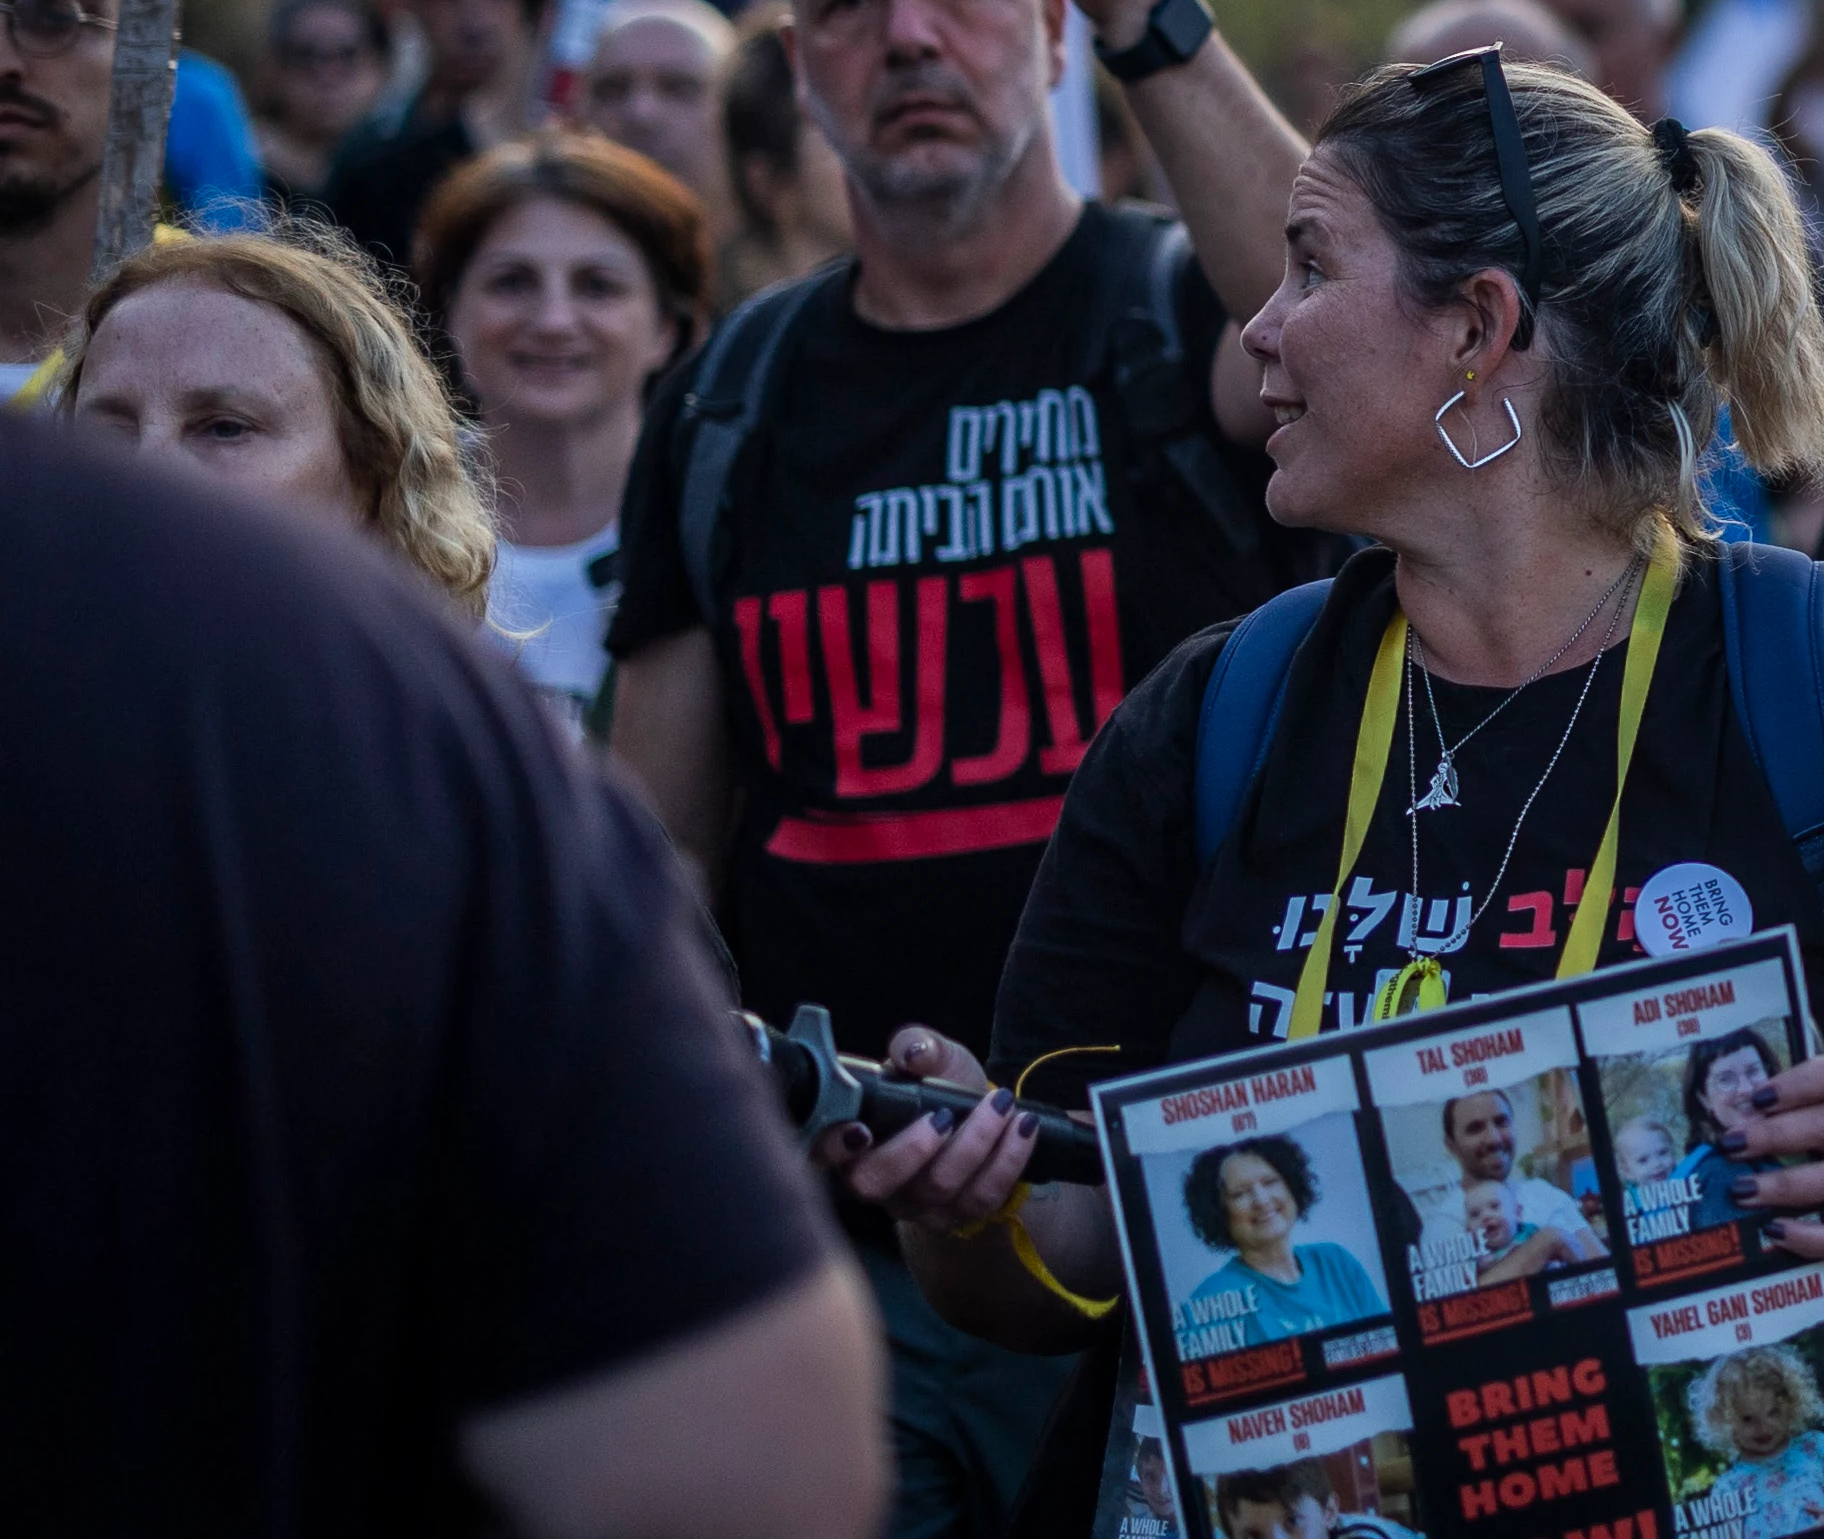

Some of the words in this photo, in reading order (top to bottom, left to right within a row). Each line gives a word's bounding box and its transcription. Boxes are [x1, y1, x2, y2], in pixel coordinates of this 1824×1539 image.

[848, 479, 994, 569] הביתה
[1002, 460, 1114, 552] אותם
[1653, 895, 1690, 950] NOW
[1671, 889, 1702, 938] HOME
[1688, 882, 1716, 927] THEM
[1703, 878, 1734, 927] BRING
[1632, 999, 1661, 1027] ADI
[1664, 979, 1736, 1020] SHOHAM
[1415, 1046, 1451, 1076] TAL
[1450, 1027, 1525, 1068] SHOHAM
[1159, 1080, 1249, 1127] SHOSHAN
[1251, 1065, 1317, 1105] HARAN
[1623, 1188, 1638, 1218] A
[1638, 1172, 1704, 1212] WHOLE
[1408, 1242, 1422, 1274] A
[1421, 1227, 1493, 1269] WHOLE
[1626, 1204, 1692, 1248] FAMILY
[1412, 1260, 1479, 1303] FAMILY
[1651, 1304, 1705, 1340] YAHEL
[1706, 1293, 1750, 1326] GANI
[1751, 1272, 1824, 1315] SHOHAM
[1172, 1301, 1188, 1331] A
[1188, 1283, 1262, 1327] WHOLE
[1176, 1318, 1248, 1362] FAMILY
[1227, 1407, 1288, 1445] NAVEH
[1289, 1386, 1368, 1429] SHOHAM
[1446, 1357, 1607, 1429] BRING
[1458, 1404, 1611, 1471] THEM
[1460, 1448, 1620, 1520] HOME
[1130, 1516, 1169, 1537] WHOLE
[1674, 1504, 1690, 1533] A
[1689, 1485, 1758, 1528] WHOLE
